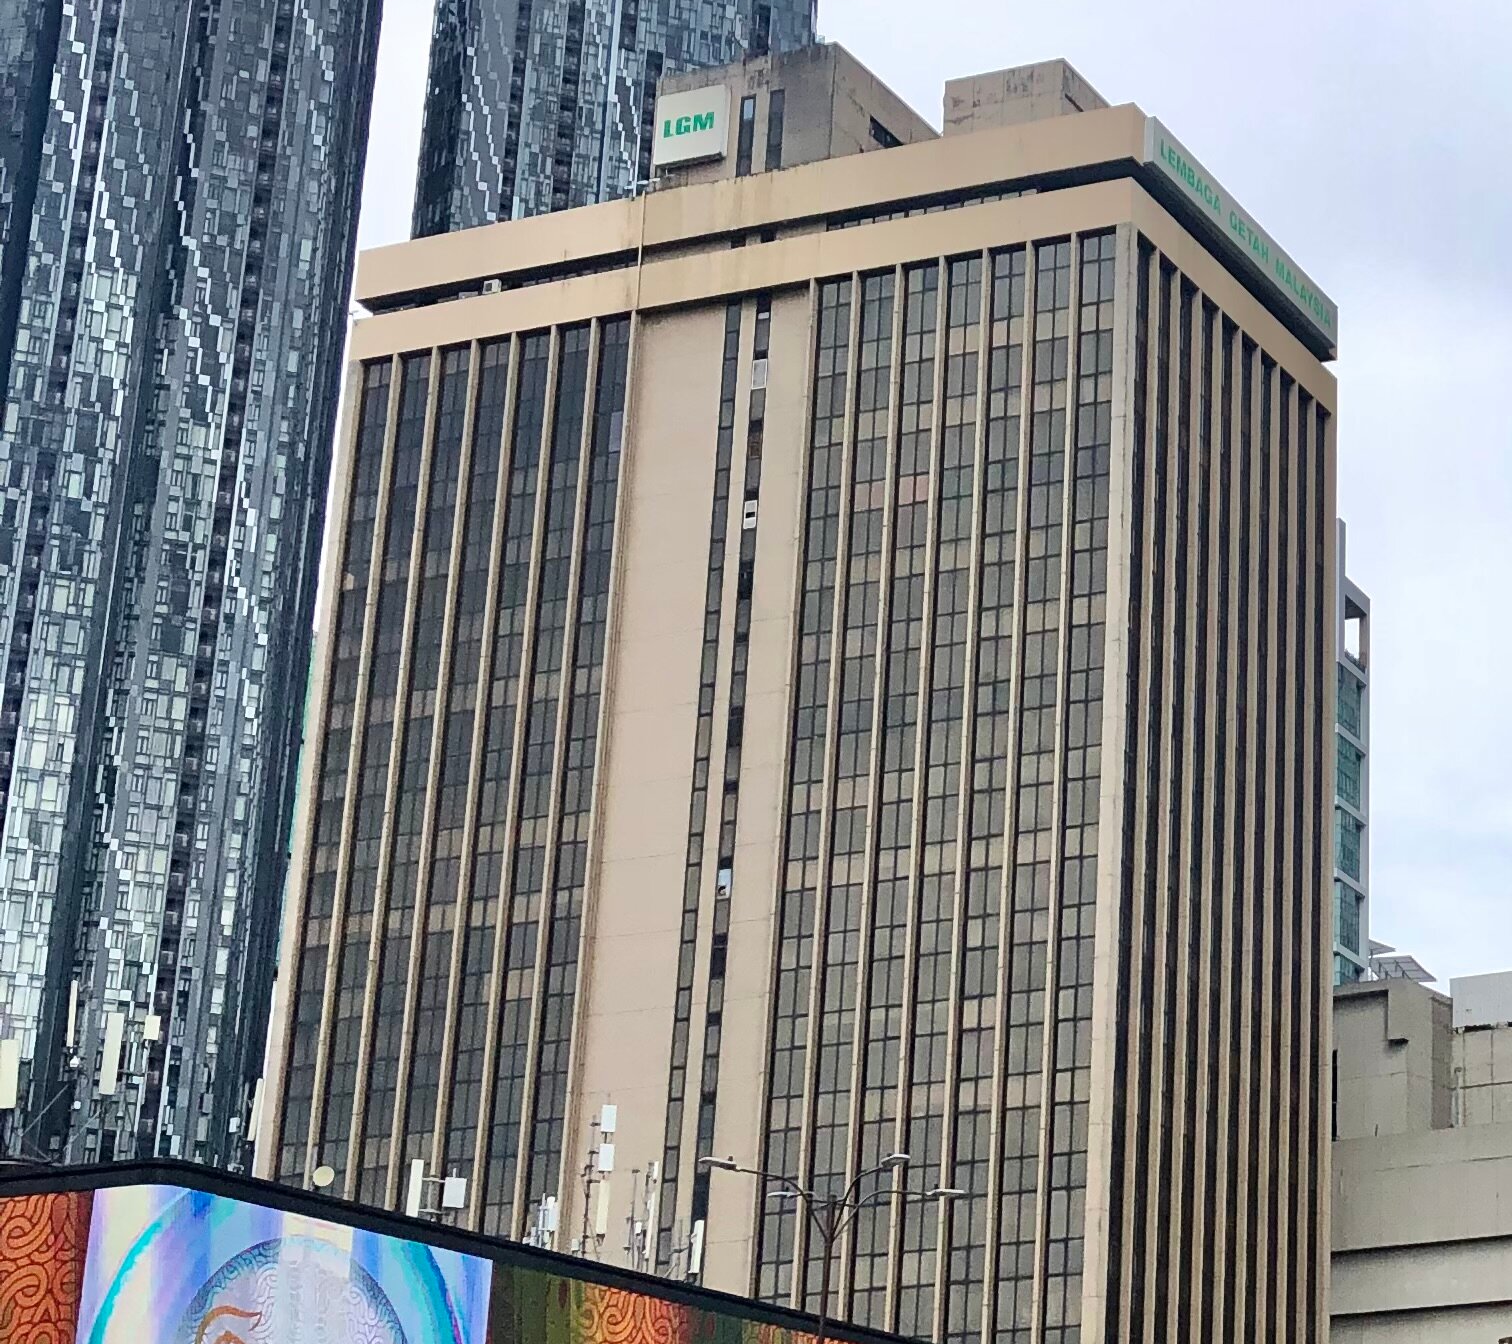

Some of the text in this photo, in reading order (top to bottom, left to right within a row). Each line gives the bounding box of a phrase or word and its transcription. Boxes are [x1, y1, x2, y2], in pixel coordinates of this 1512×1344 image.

[663, 111, 715, 138] LGM
[1160, 139, 1332, 328] LEMBAGA GETAH MALAYSIA
